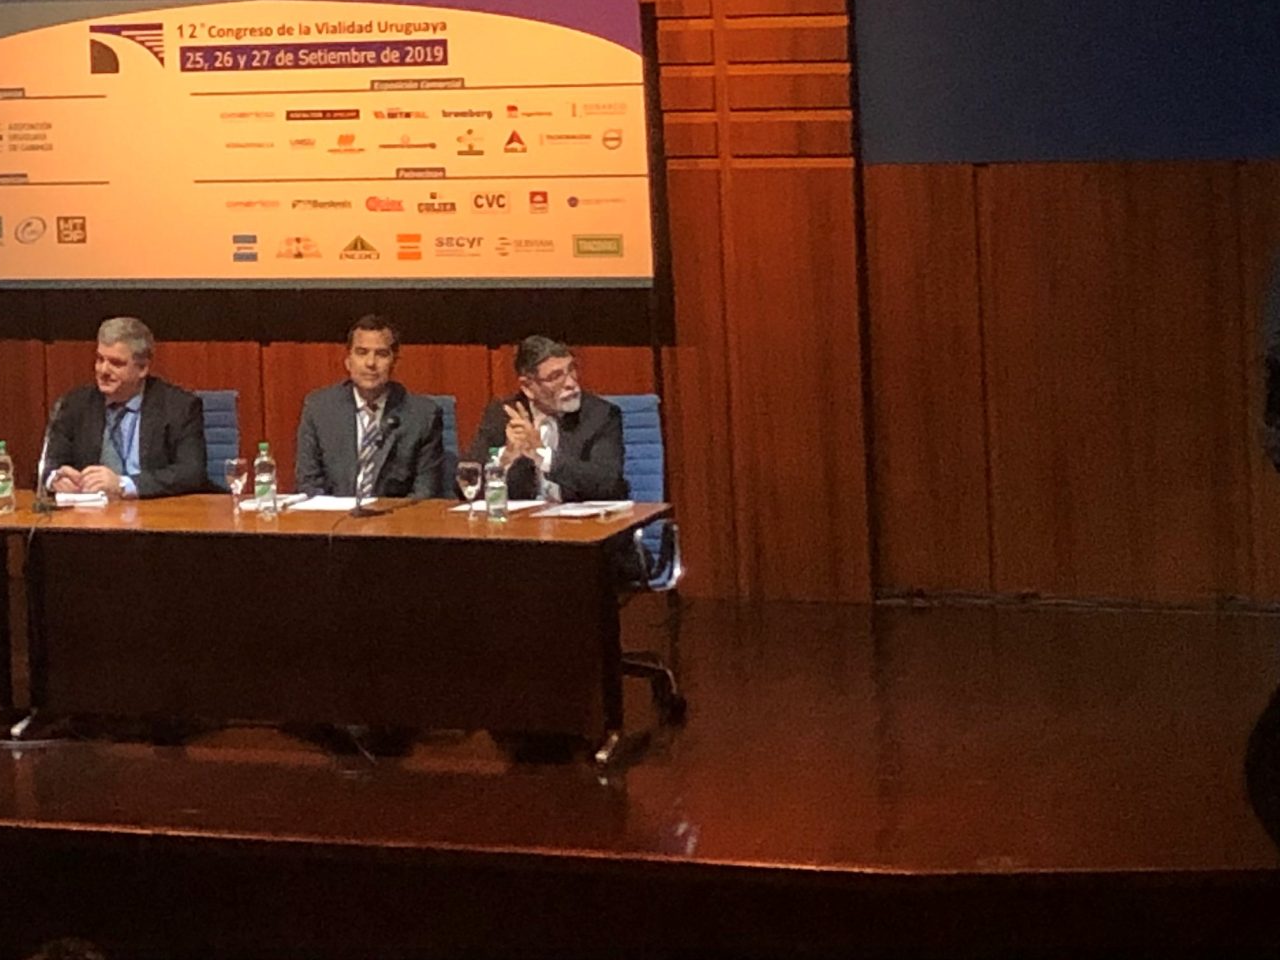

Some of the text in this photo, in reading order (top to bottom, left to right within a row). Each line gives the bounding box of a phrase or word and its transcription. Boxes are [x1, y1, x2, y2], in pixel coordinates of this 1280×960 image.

[208, 23, 274, 41] Congreso
[277, 21, 295, 37] de
[298, 21, 312, 37] la
[315, 19, 374, 36] Vialidad
[377, 18, 448, 35] Uruguaya
[213, 51, 234, 68] 26
[237, 53, 248, 69] y
[251, 50, 272, 67] 27
[275, 48, 295, 66] de
[298, 45, 377, 66] Setiembre
[380, 46, 401, 64] de
[404, 45, 445, 63] 2019
[473, 193, 507, 210] CVC
